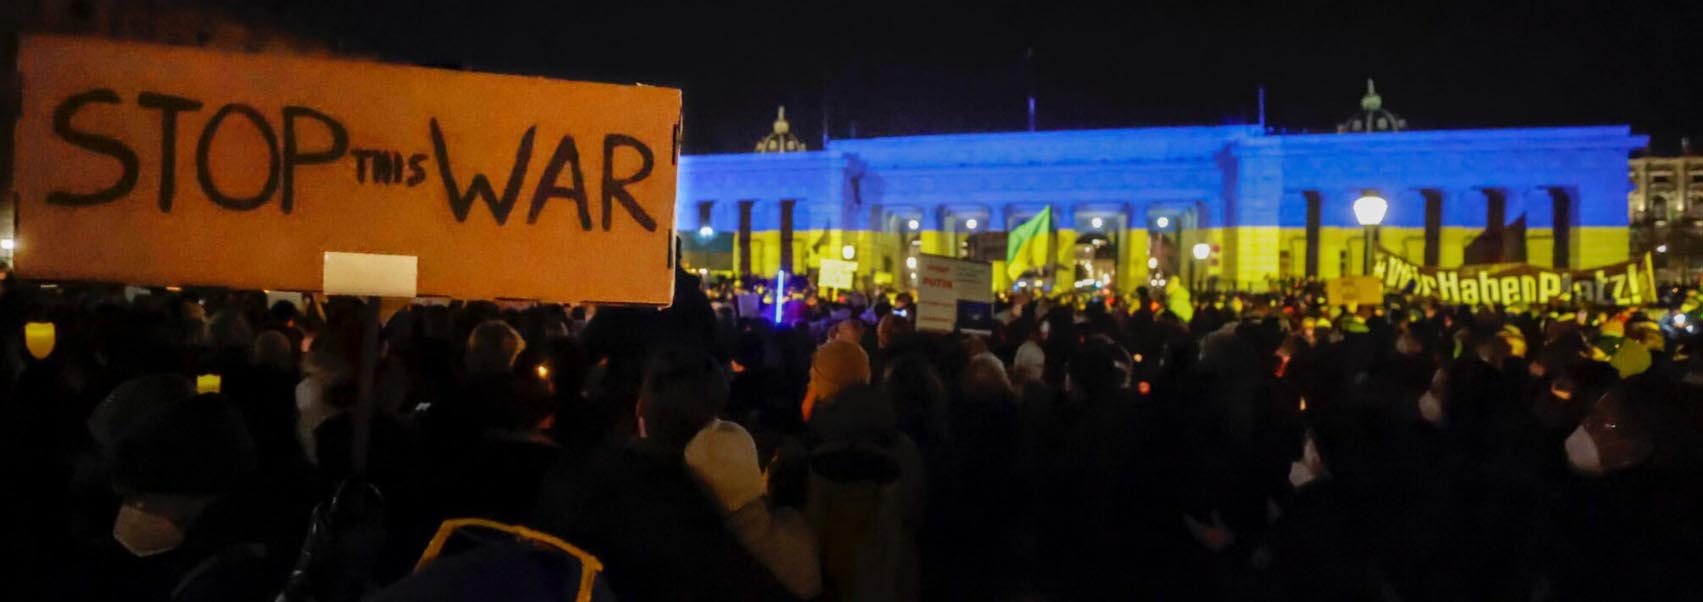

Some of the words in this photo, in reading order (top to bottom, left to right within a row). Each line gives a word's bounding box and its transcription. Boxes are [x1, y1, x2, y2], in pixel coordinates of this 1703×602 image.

[46, 88, 348, 215] STOP
[350, 147, 428, 187] THIS
[430, 117, 656, 233] WAR
